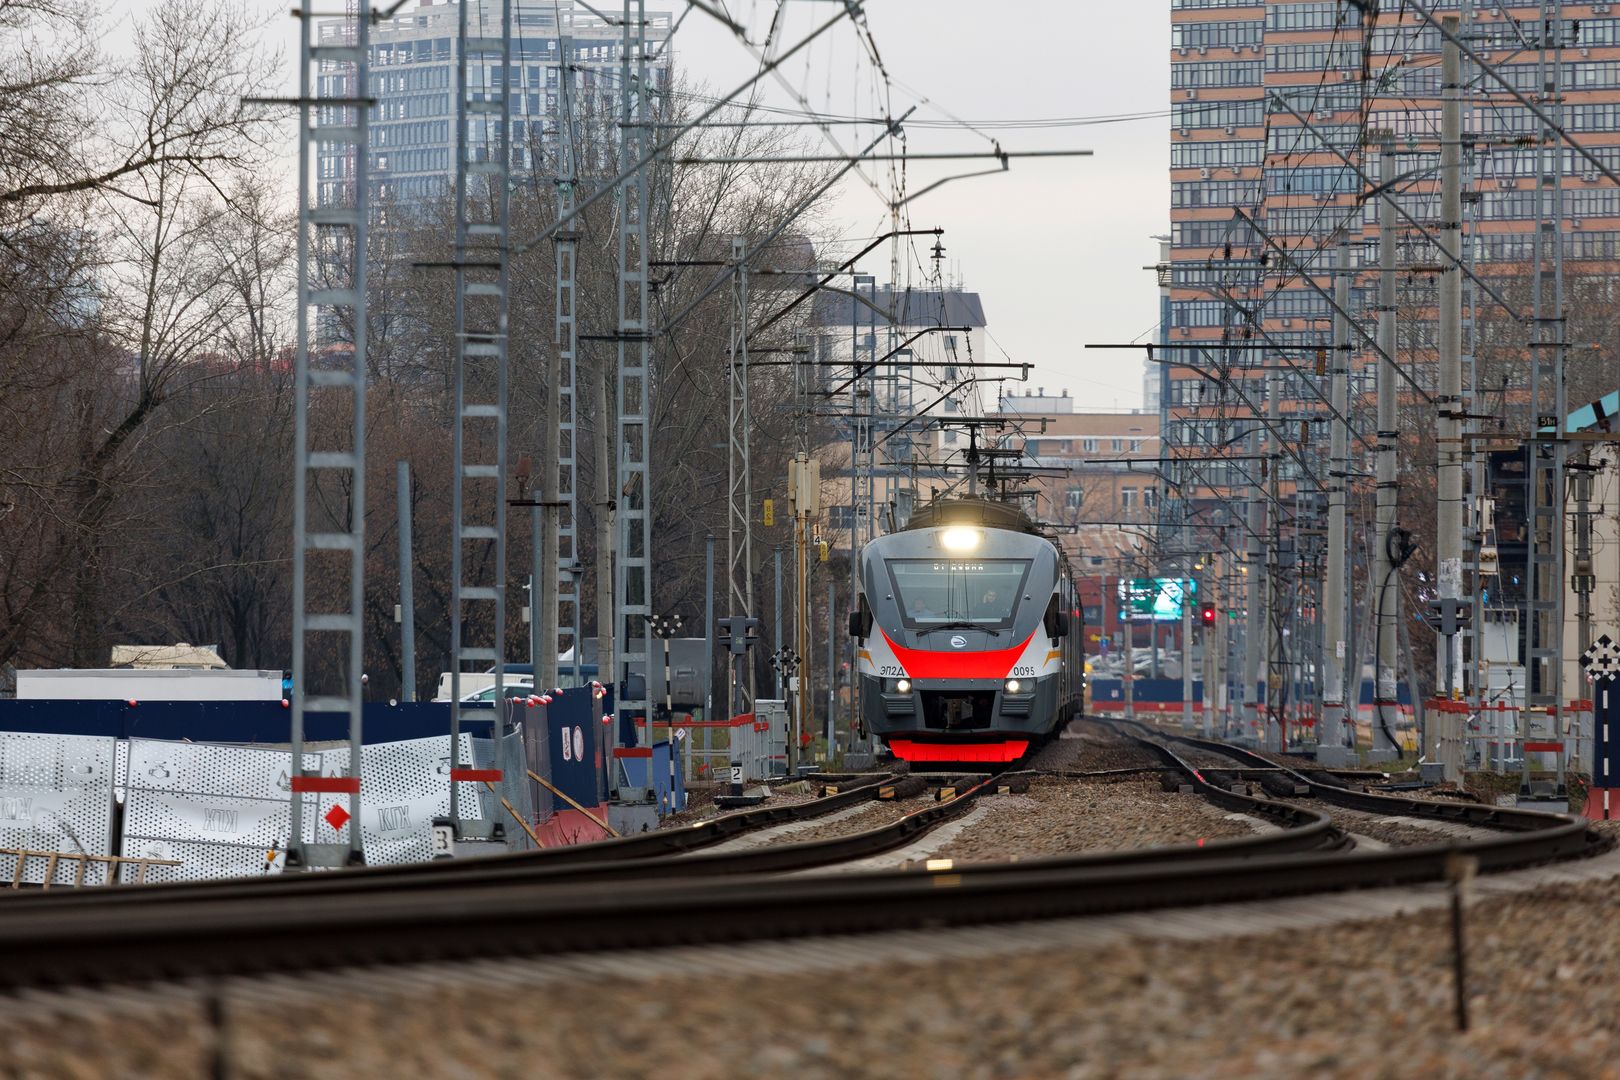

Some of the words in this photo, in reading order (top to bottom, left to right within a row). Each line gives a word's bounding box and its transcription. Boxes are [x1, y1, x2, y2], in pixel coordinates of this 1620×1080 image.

[880, 666, 905, 677] ЭП2Д
[1013, 666, 1035, 677] 0095
[733, 767, 741, 780] 2
[436, 830, 448, 850] 3
